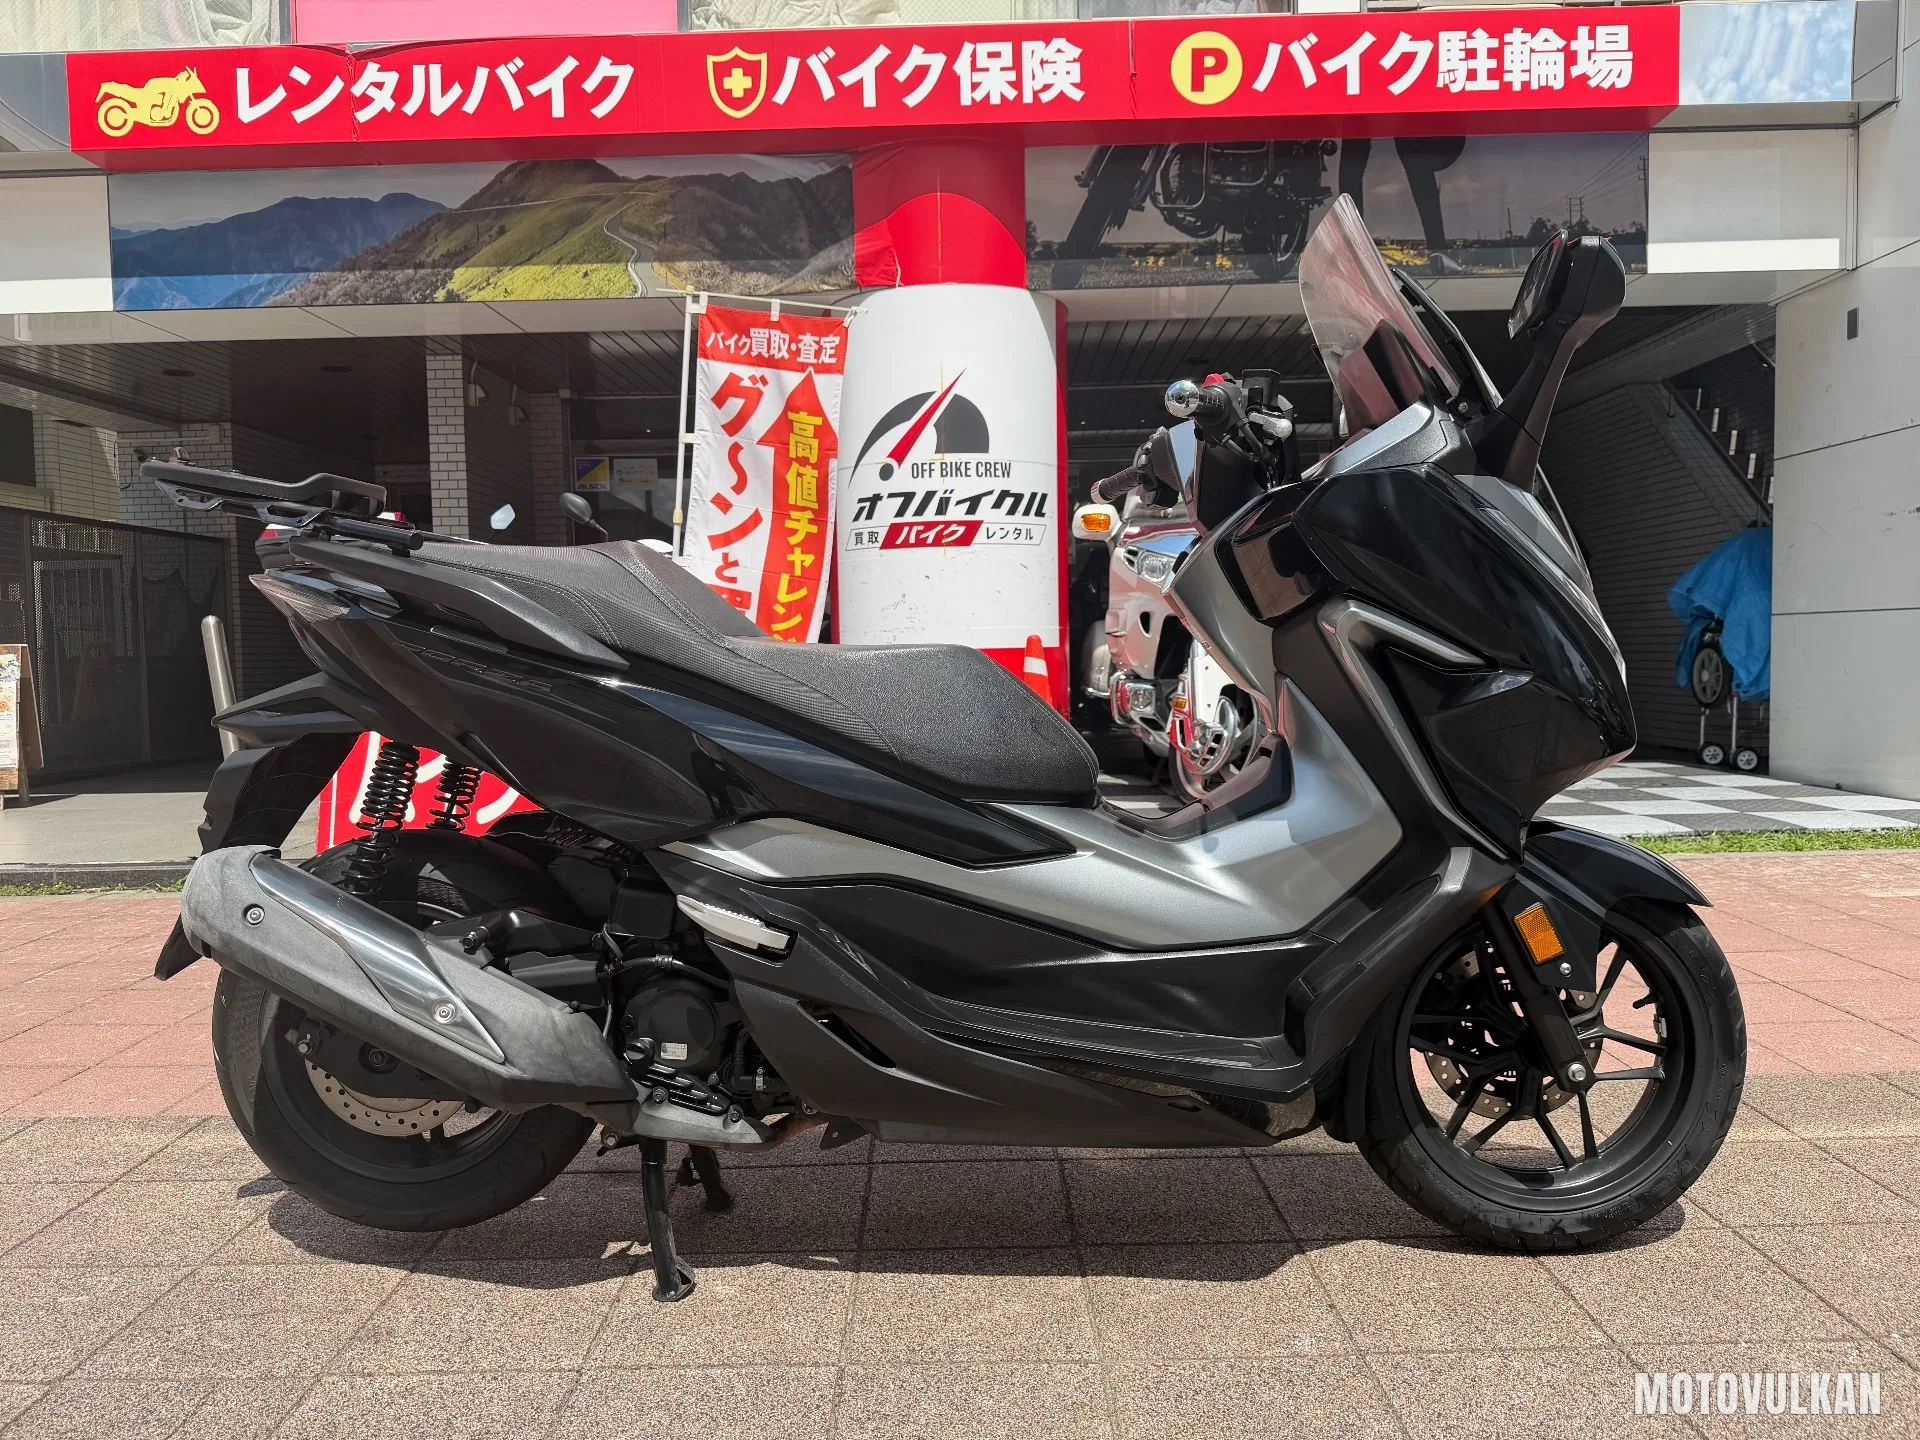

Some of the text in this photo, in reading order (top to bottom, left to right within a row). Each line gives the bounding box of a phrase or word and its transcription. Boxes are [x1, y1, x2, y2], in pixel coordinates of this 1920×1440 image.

[772, 37, 1086, 108] バイク保険
[1190, 47, 1229, 93] P
[1252, 24, 1634, 95] バイク駐輪場
[236, 54, 635, 124] レンタルバイク
[705, 327, 841, 364] バイク買取・査定
[911, 461, 1012, 479] OFF BIKE CREW
[770, 411, 823, 642] 高値チャレン
[852, 489, 1049, 522] オフバイクル
[854, 523, 1034, 546] 買取 バイク レンタル
